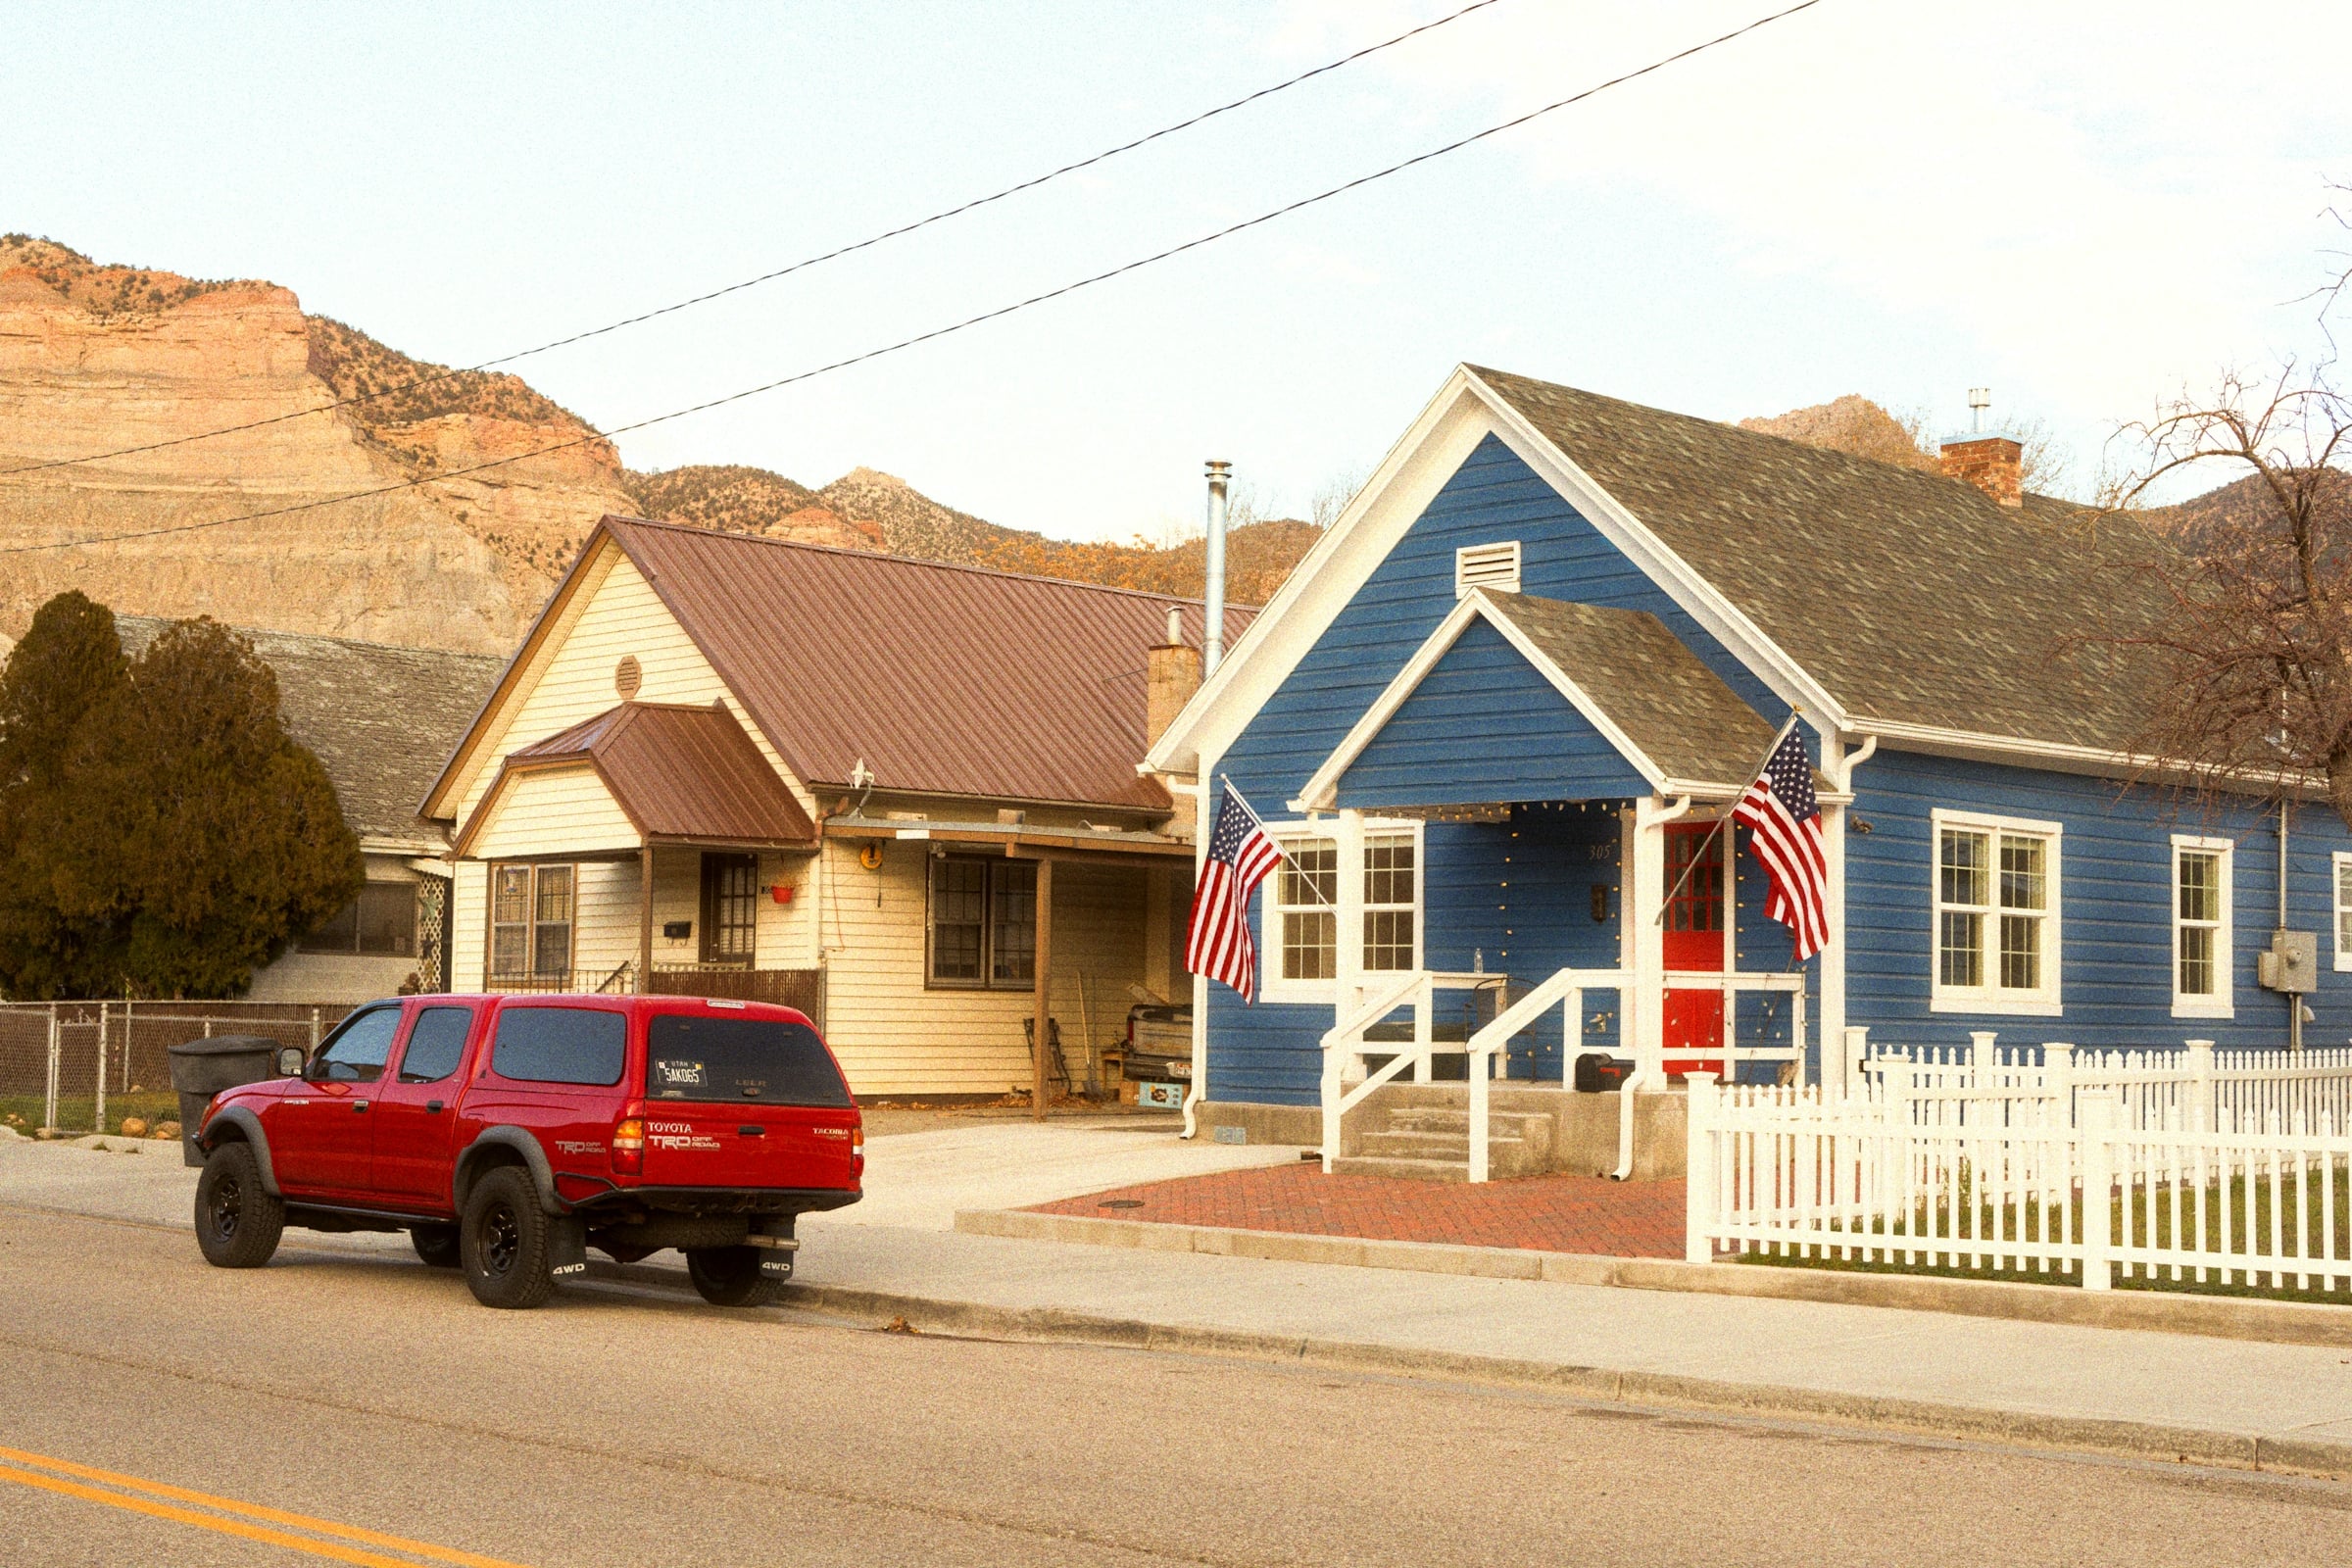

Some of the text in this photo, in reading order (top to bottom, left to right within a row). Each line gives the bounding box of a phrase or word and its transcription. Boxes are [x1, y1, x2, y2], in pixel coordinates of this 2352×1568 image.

[664, 1067, 700, 1083] 5AK065
[647, 1121, 693, 1133] TOYOTA
[555, 1141, 586, 1154] TRD
[648, 1135, 691, 1150] TRD
[552, 1263, 585, 1275] 4WD
[761, 1261, 791, 1271] 4WD
